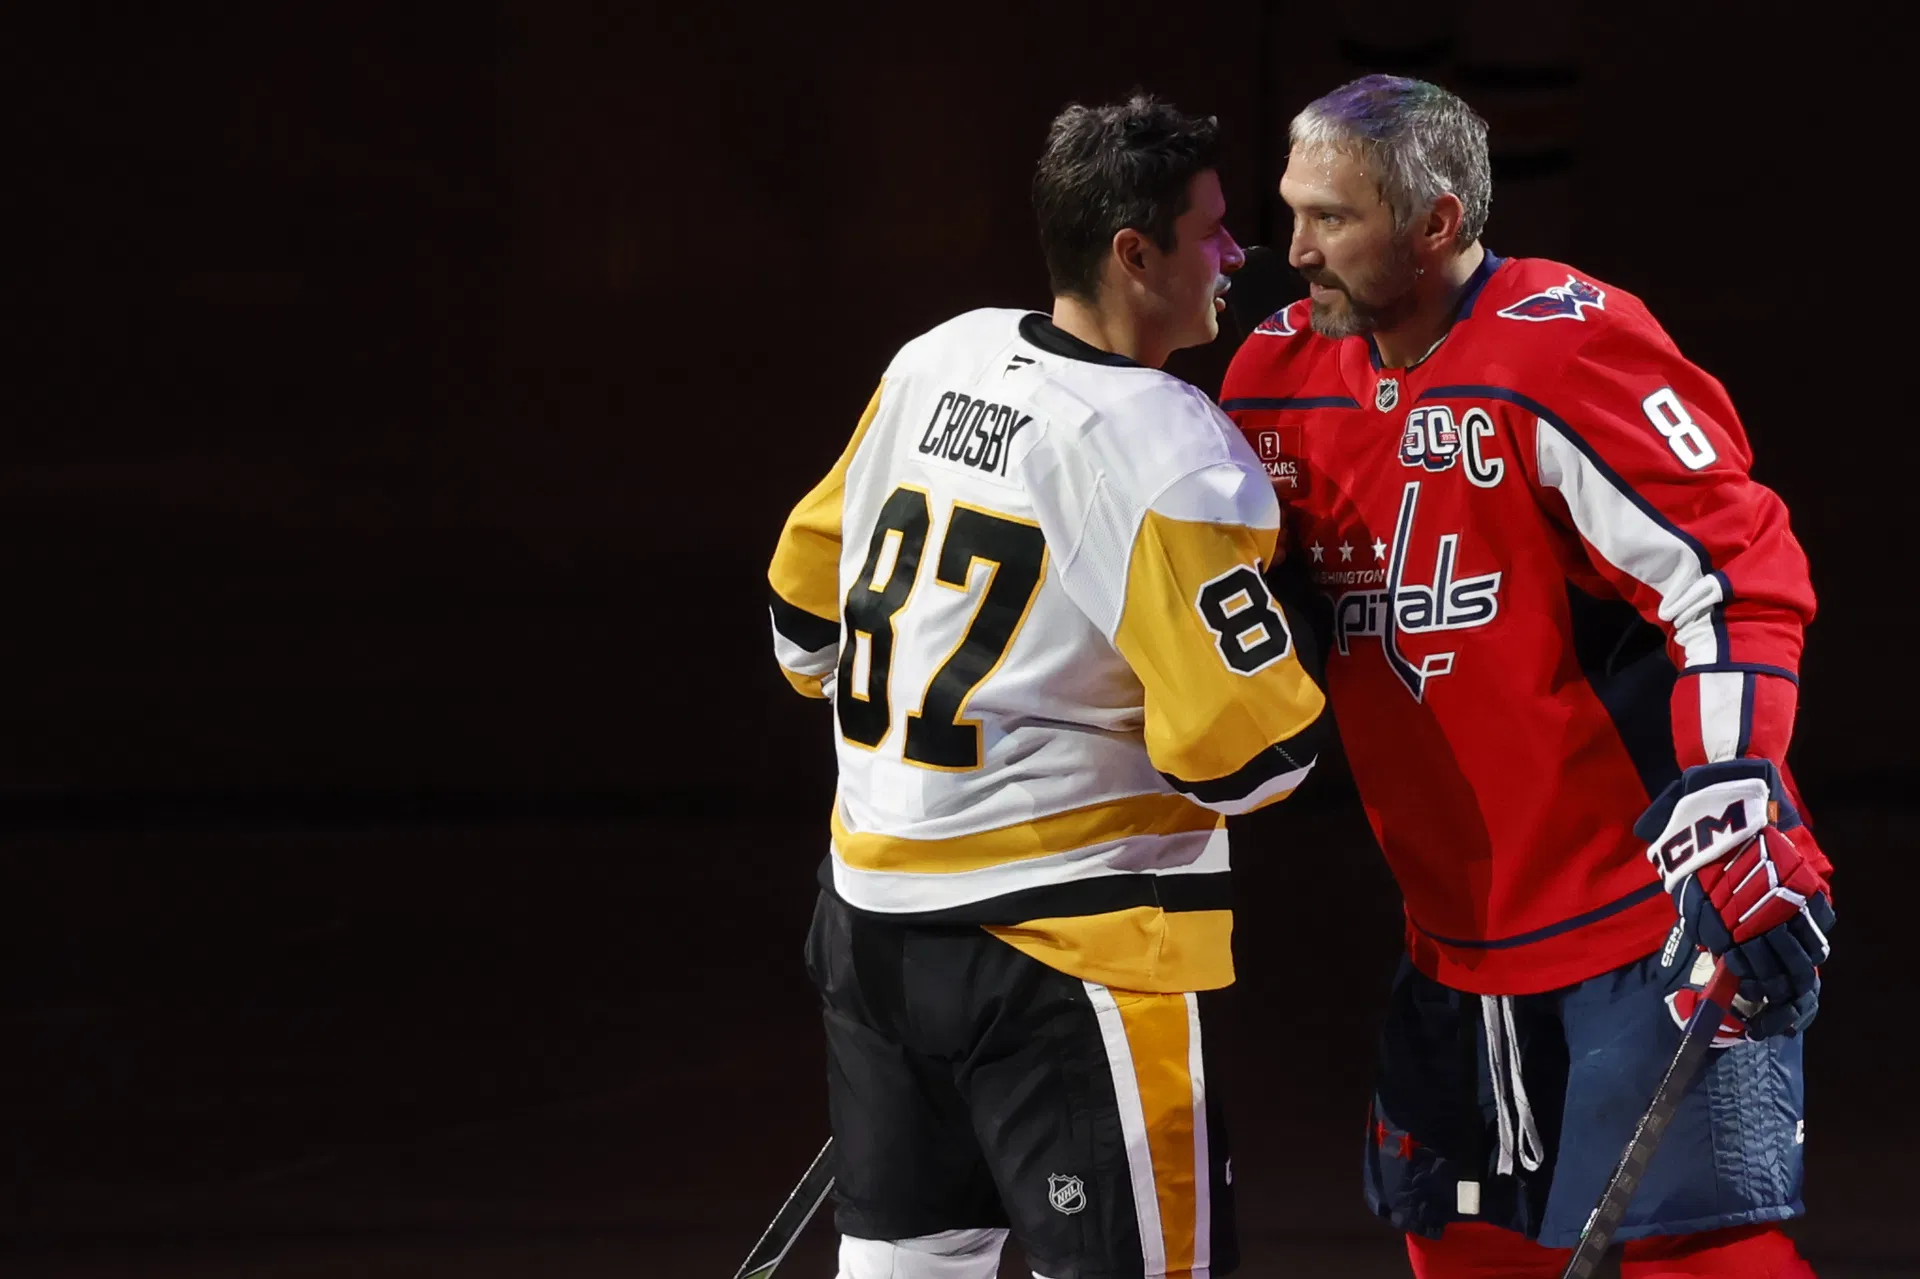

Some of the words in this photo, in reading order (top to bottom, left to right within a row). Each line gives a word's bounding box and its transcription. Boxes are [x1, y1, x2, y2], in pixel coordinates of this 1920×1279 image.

[918, 390, 1033, 477] CROSBY
[1404, 408, 1457, 458] 50
[1461, 407, 1504, 488] C
[1642, 386, 1717, 471] 8
[837, 482, 1050, 772] 87
[1195, 557, 1291, 677] 8
[1333, 481, 1502, 704] pitals
[1057, 1184, 1077, 1206] NHL
